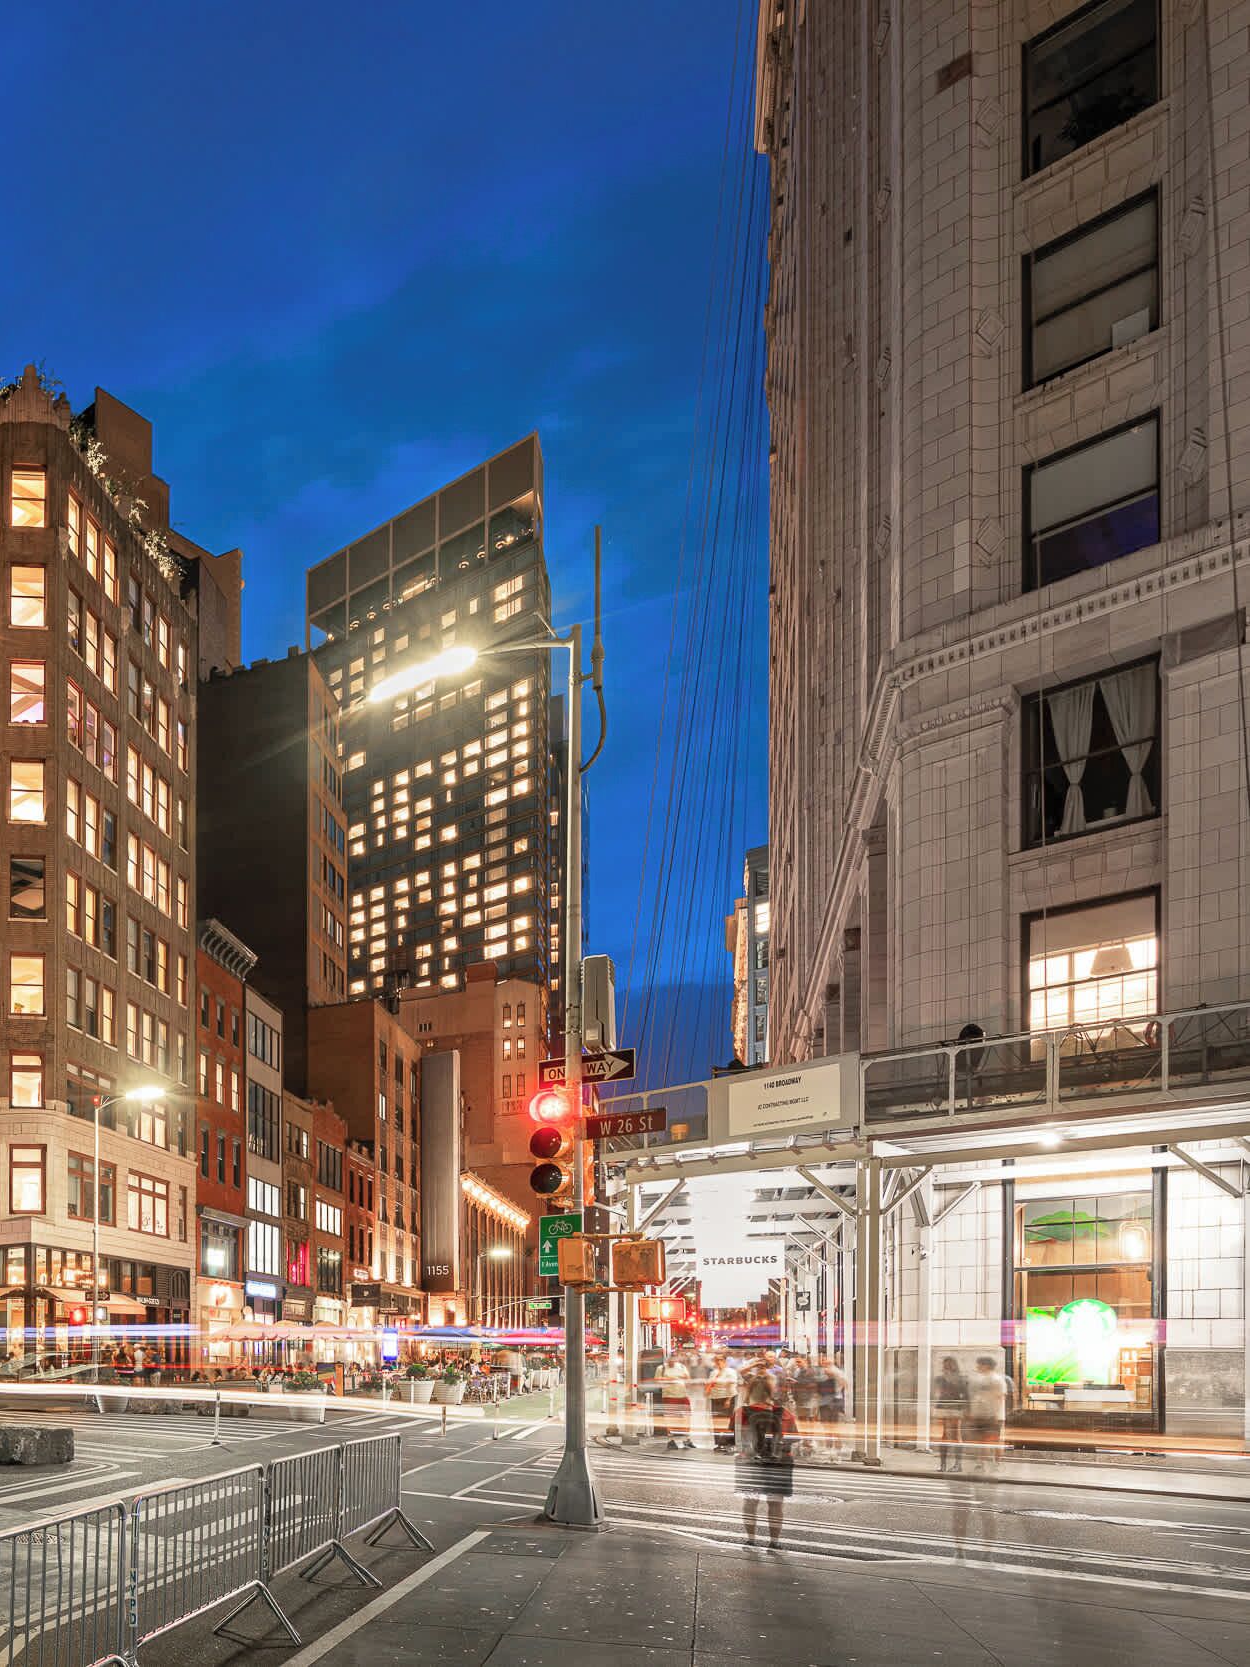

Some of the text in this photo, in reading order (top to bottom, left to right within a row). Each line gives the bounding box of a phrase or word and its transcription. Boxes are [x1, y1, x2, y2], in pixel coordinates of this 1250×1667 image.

[549, 1061, 614, 1080] ON WAY
[775, 1076, 802, 1088] BROADWAY
[600, 1115, 653, 1135] W 26 St
[703, 1255, 778, 1266] STARBUCKS
[427, 1265, 449, 1276] 1155
